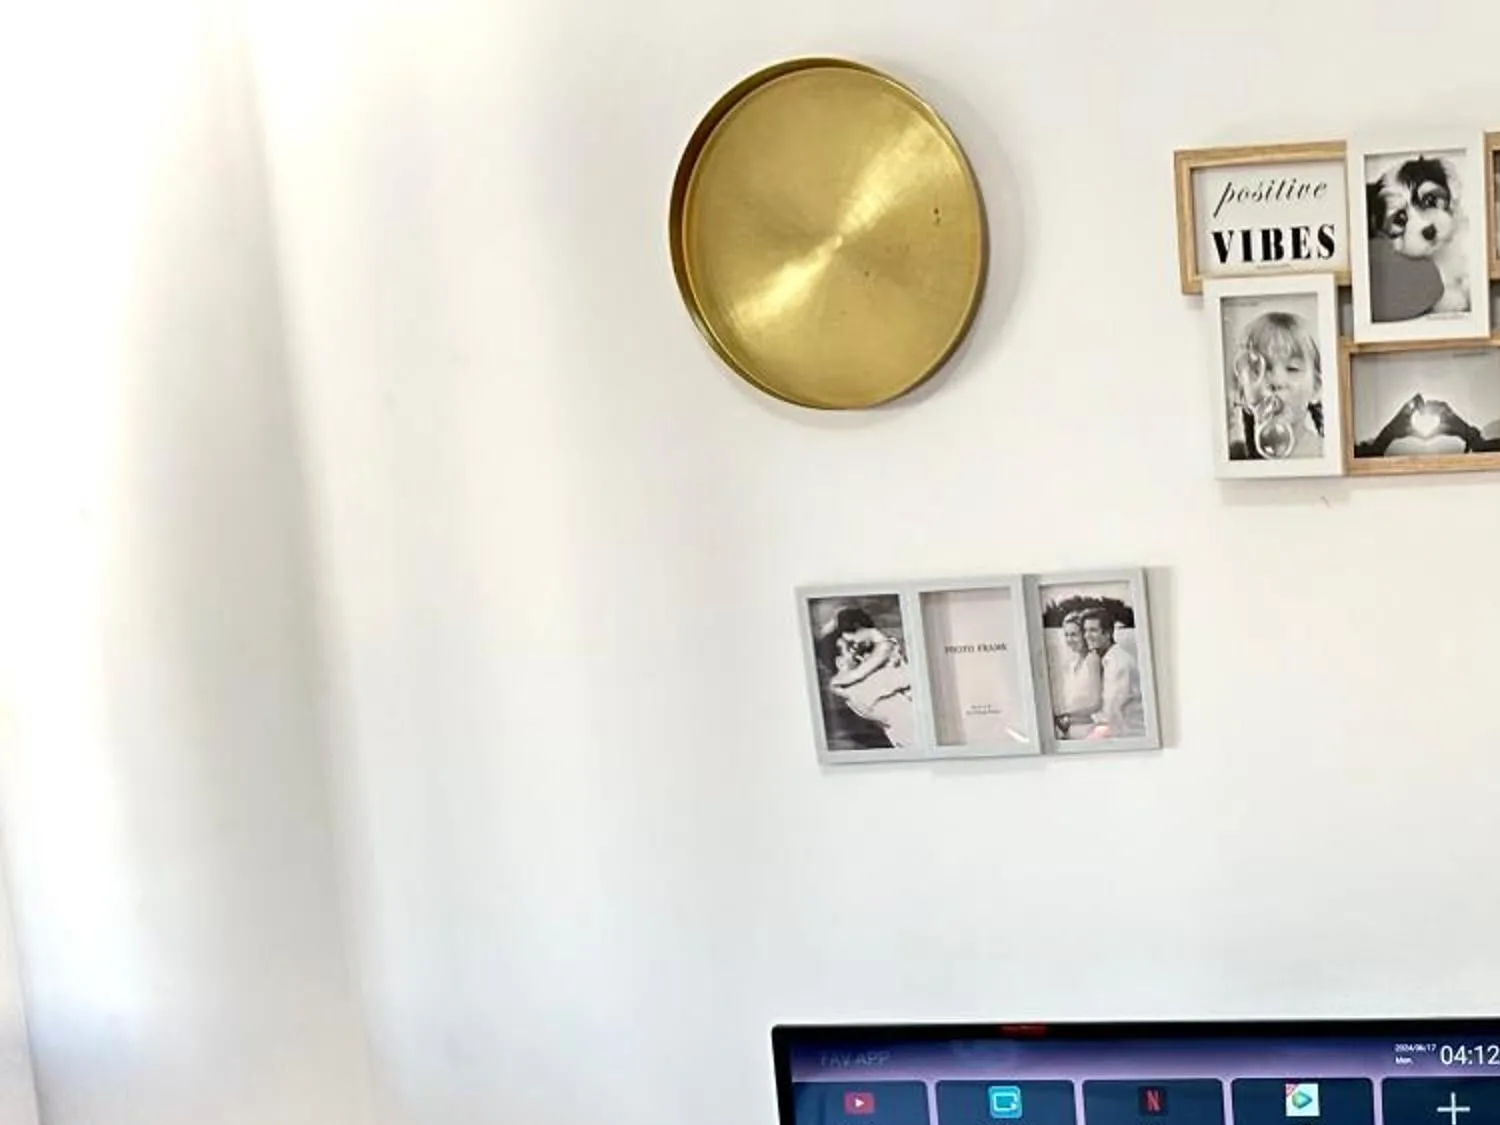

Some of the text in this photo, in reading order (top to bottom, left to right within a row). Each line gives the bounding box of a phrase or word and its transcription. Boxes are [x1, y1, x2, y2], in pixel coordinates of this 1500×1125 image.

[1212, 178, 1328, 219] positive
[1210, 223, 1336, 264] VIBES
[1440, 1044, 1500, 1065] 04:12
